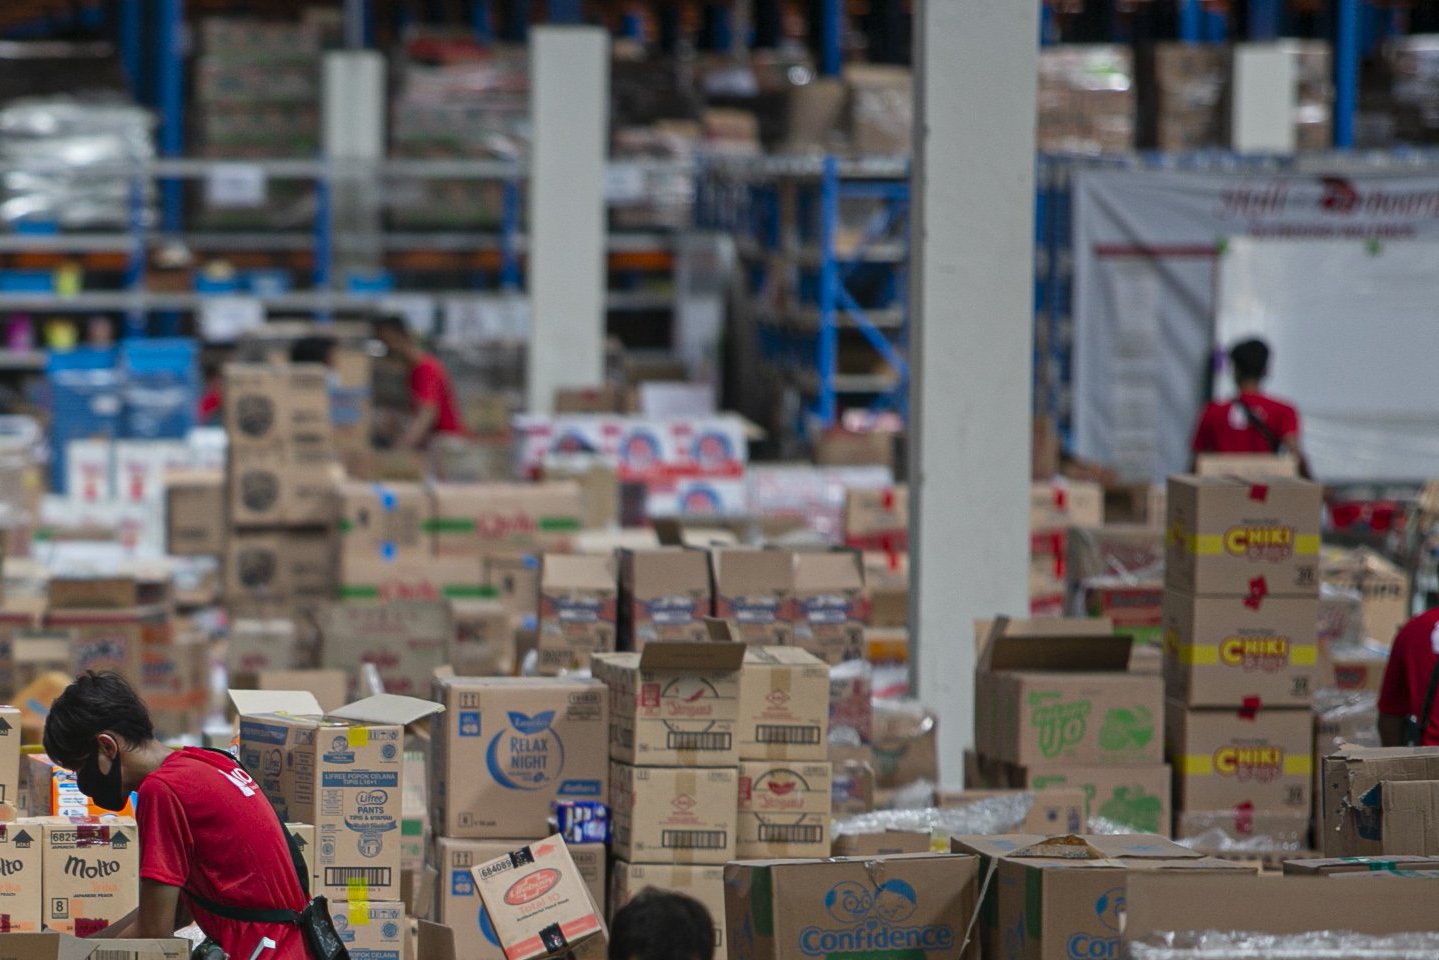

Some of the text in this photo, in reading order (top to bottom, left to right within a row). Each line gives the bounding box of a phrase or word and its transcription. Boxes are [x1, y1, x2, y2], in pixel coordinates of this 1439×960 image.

[510, 738, 549, 752] RELAX
[510, 755, 547, 769] NIGHT
[359, 793, 384, 804] Lifree
[357, 806, 385, 815] PANTS
[64, 855, 121, 879] Molto
[55, 900, 64, 912] 8
[800, 925, 954, 955] Confidence
